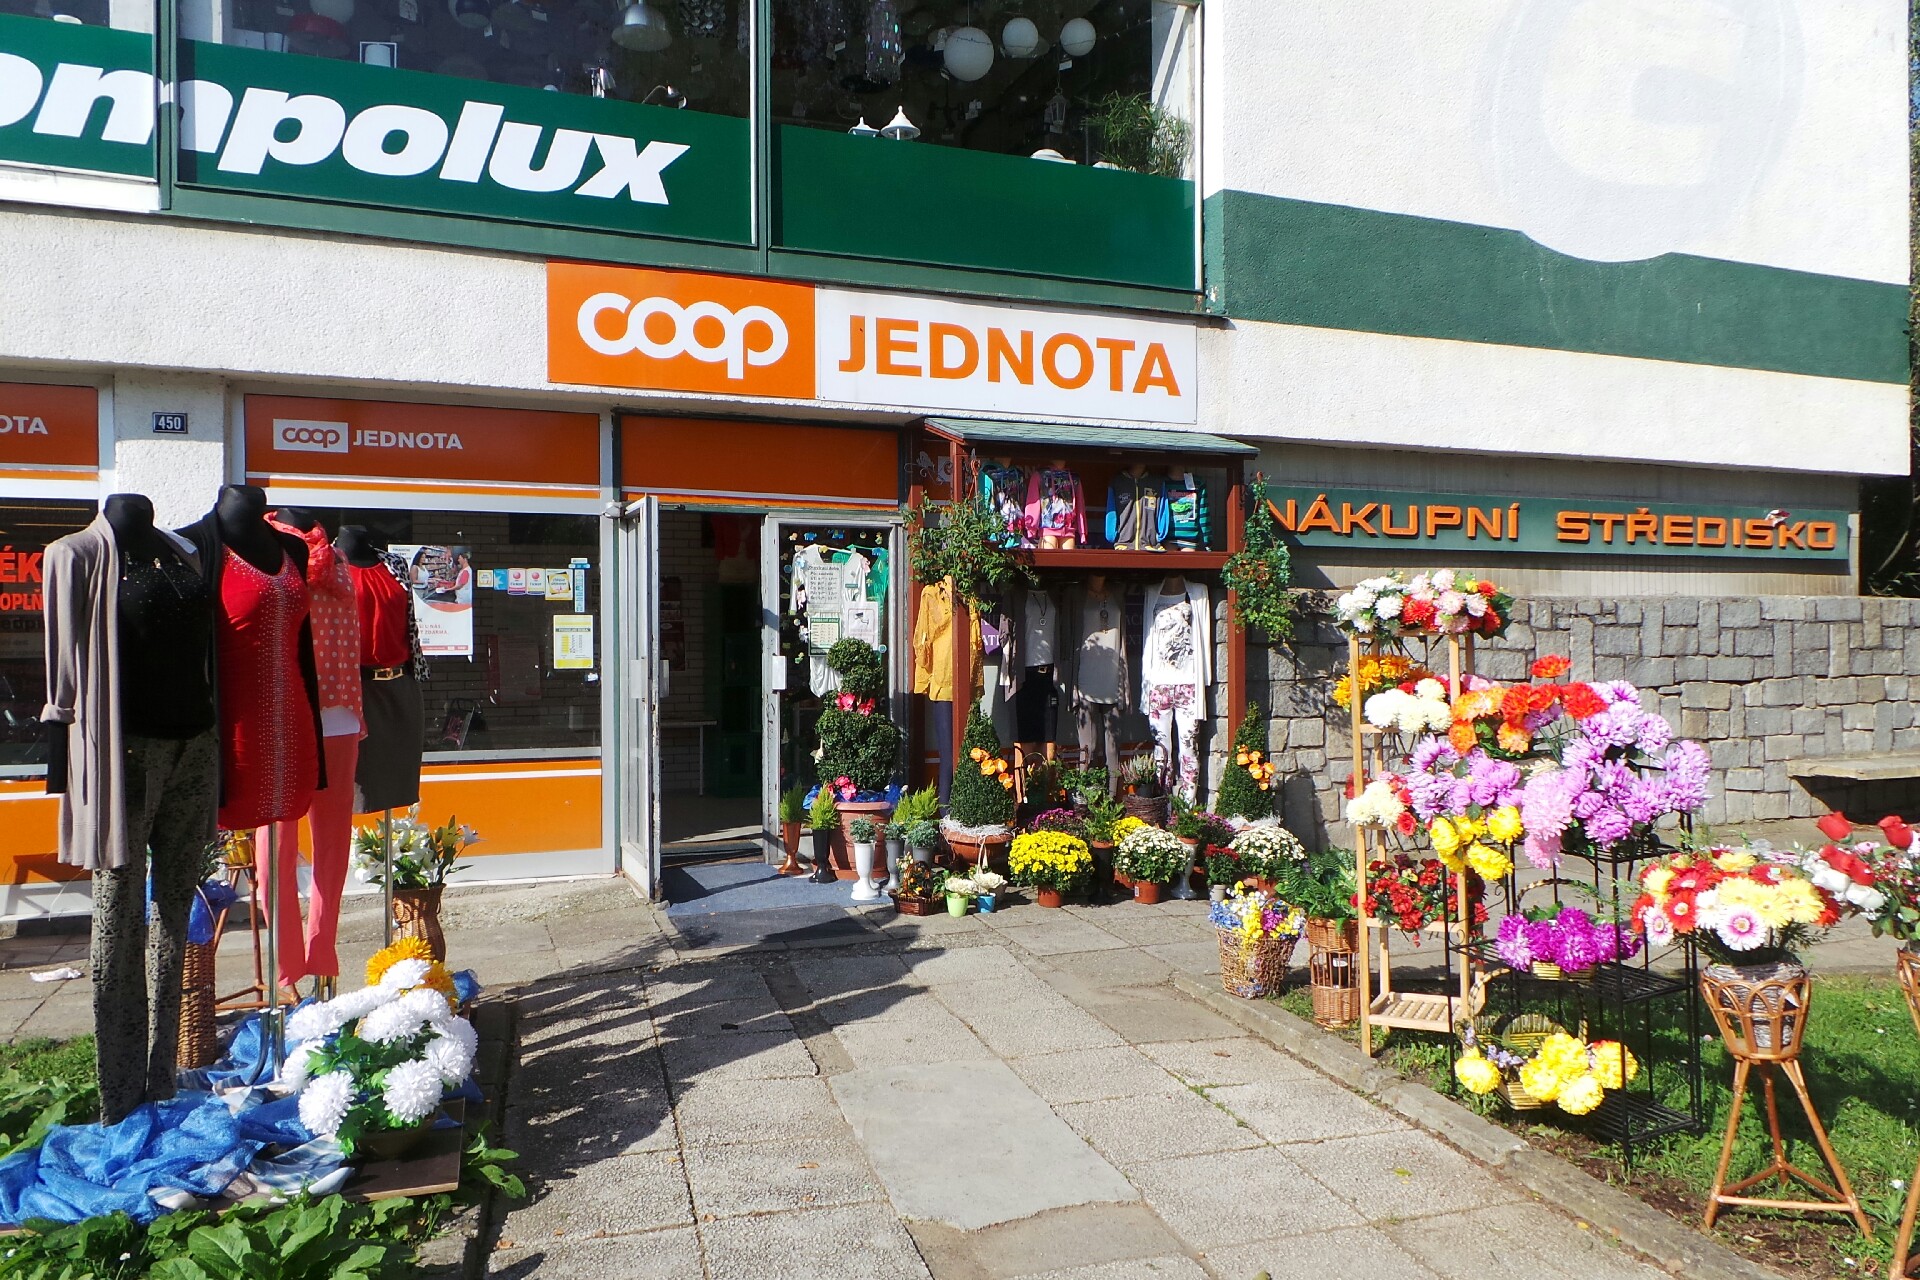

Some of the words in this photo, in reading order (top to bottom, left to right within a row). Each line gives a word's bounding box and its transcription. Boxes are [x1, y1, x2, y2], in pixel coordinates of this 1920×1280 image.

[577, 292, 789, 379] coop
[838, 315, 1182, 397] JEDNOTA
[158, 416, 182, 429] 450
[282, 427, 340, 448] coop
[353, 430, 463, 449] JEDNOTA
[1267, 493, 1520, 539] NÁKUPNÍ
[1557, 507, 1836, 549] STŘEDISKO
